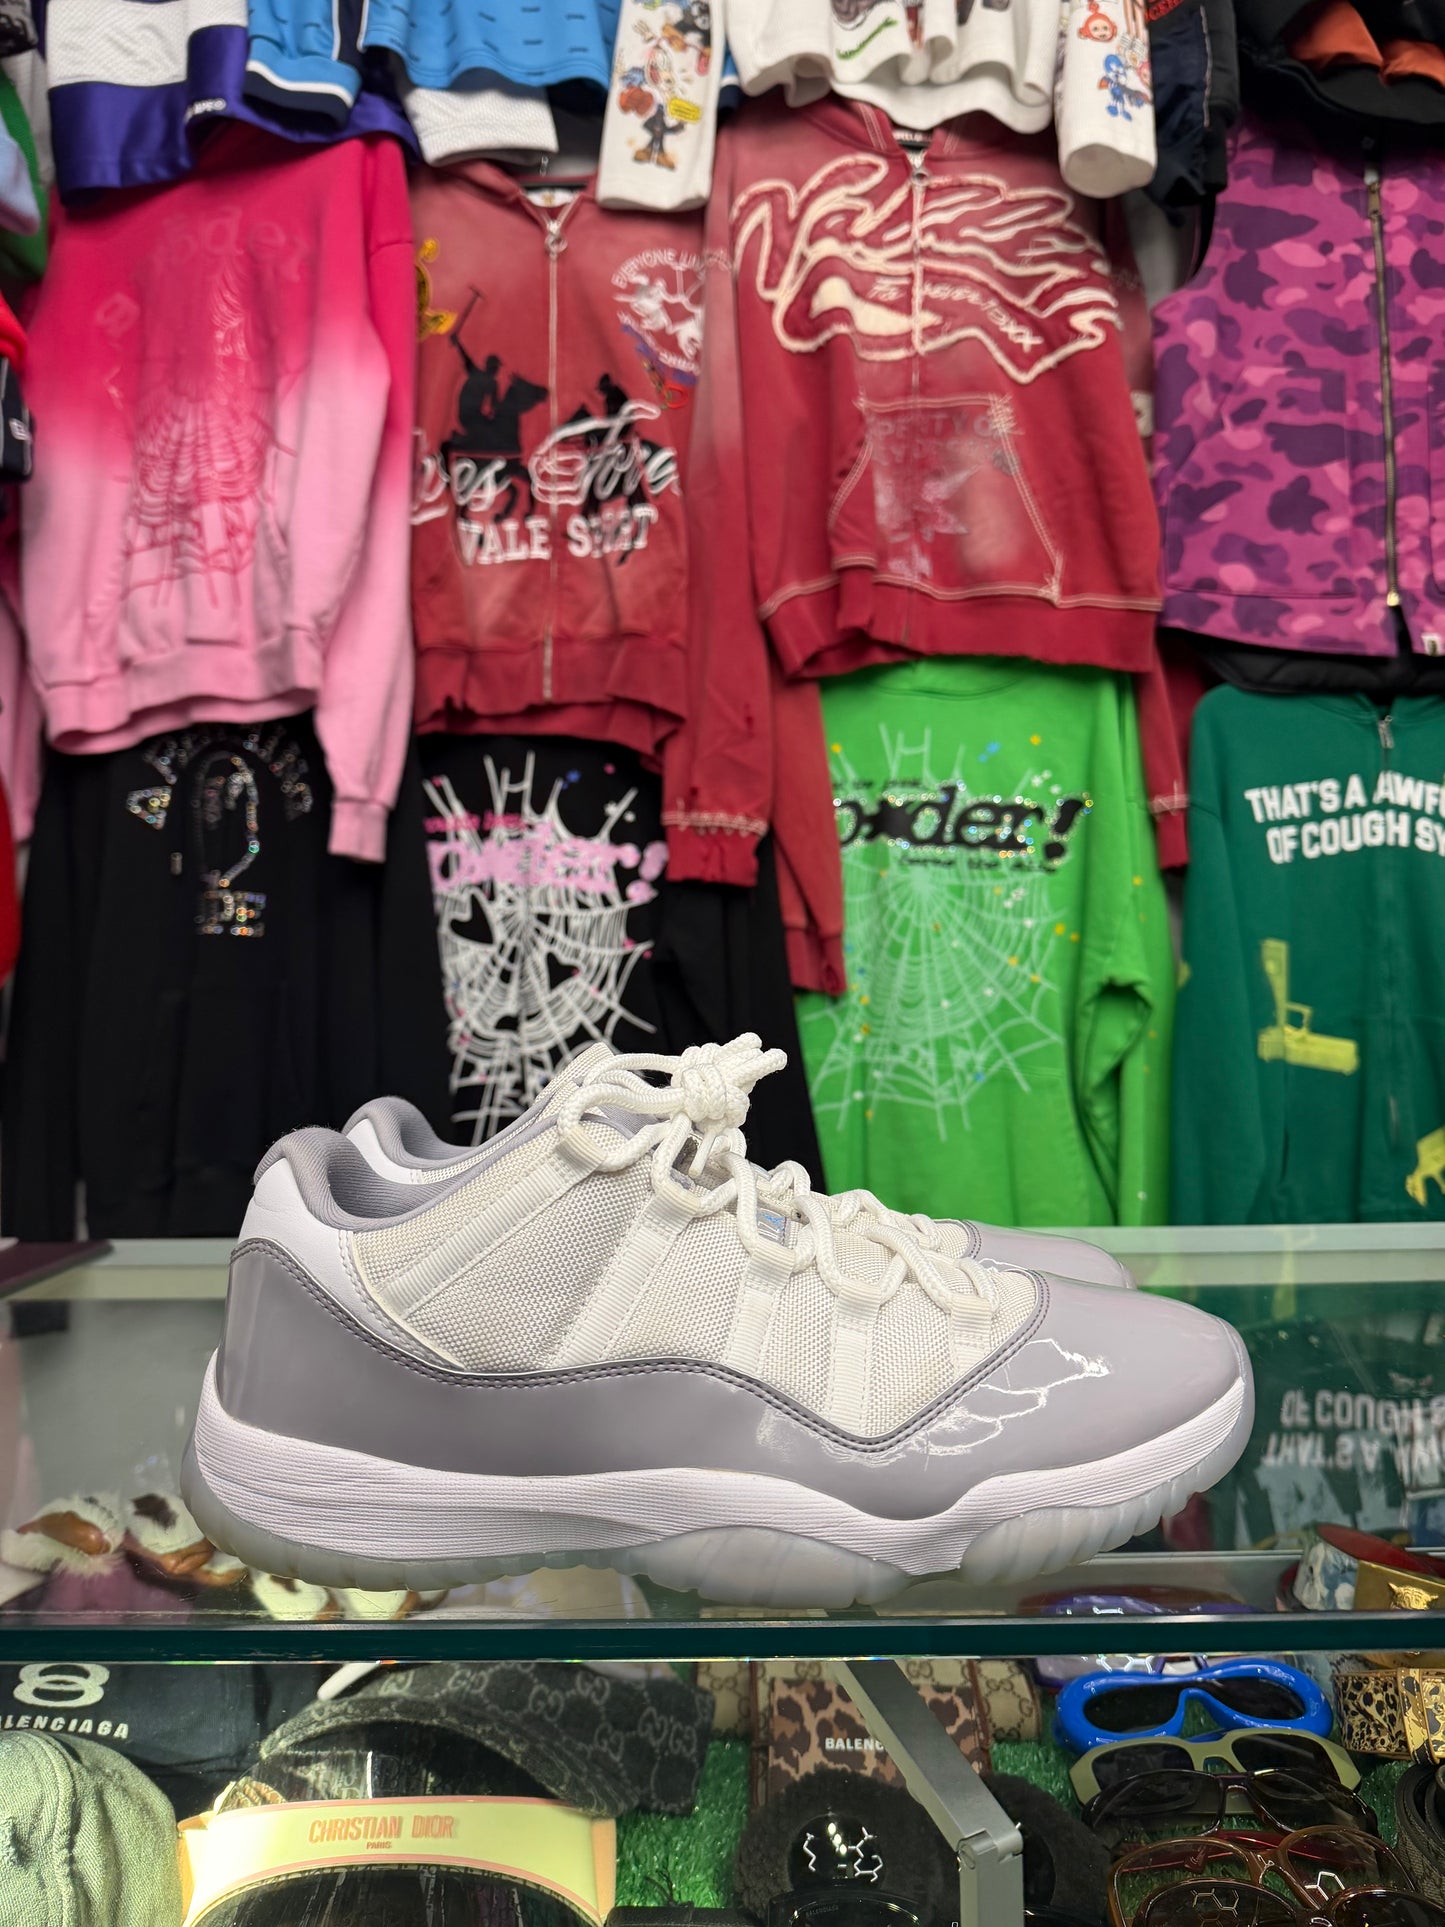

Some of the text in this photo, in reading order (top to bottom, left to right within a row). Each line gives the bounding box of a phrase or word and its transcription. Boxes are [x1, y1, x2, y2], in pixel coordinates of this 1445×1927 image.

[457, 515, 551, 565] VALE
[1244, 777, 1341, 823] THAT'S
[1344, 773, 1367, 809] A
[1266, 825, 1298, 864] OF
[1301, 809, 1410, 859] COUGH
[0, 1714, 129, 1739] LENCIAGA
[309, 1814, 455, 1843] CHRISTIAN DIOR
[366, 1841, 392, 1849] PARIS
